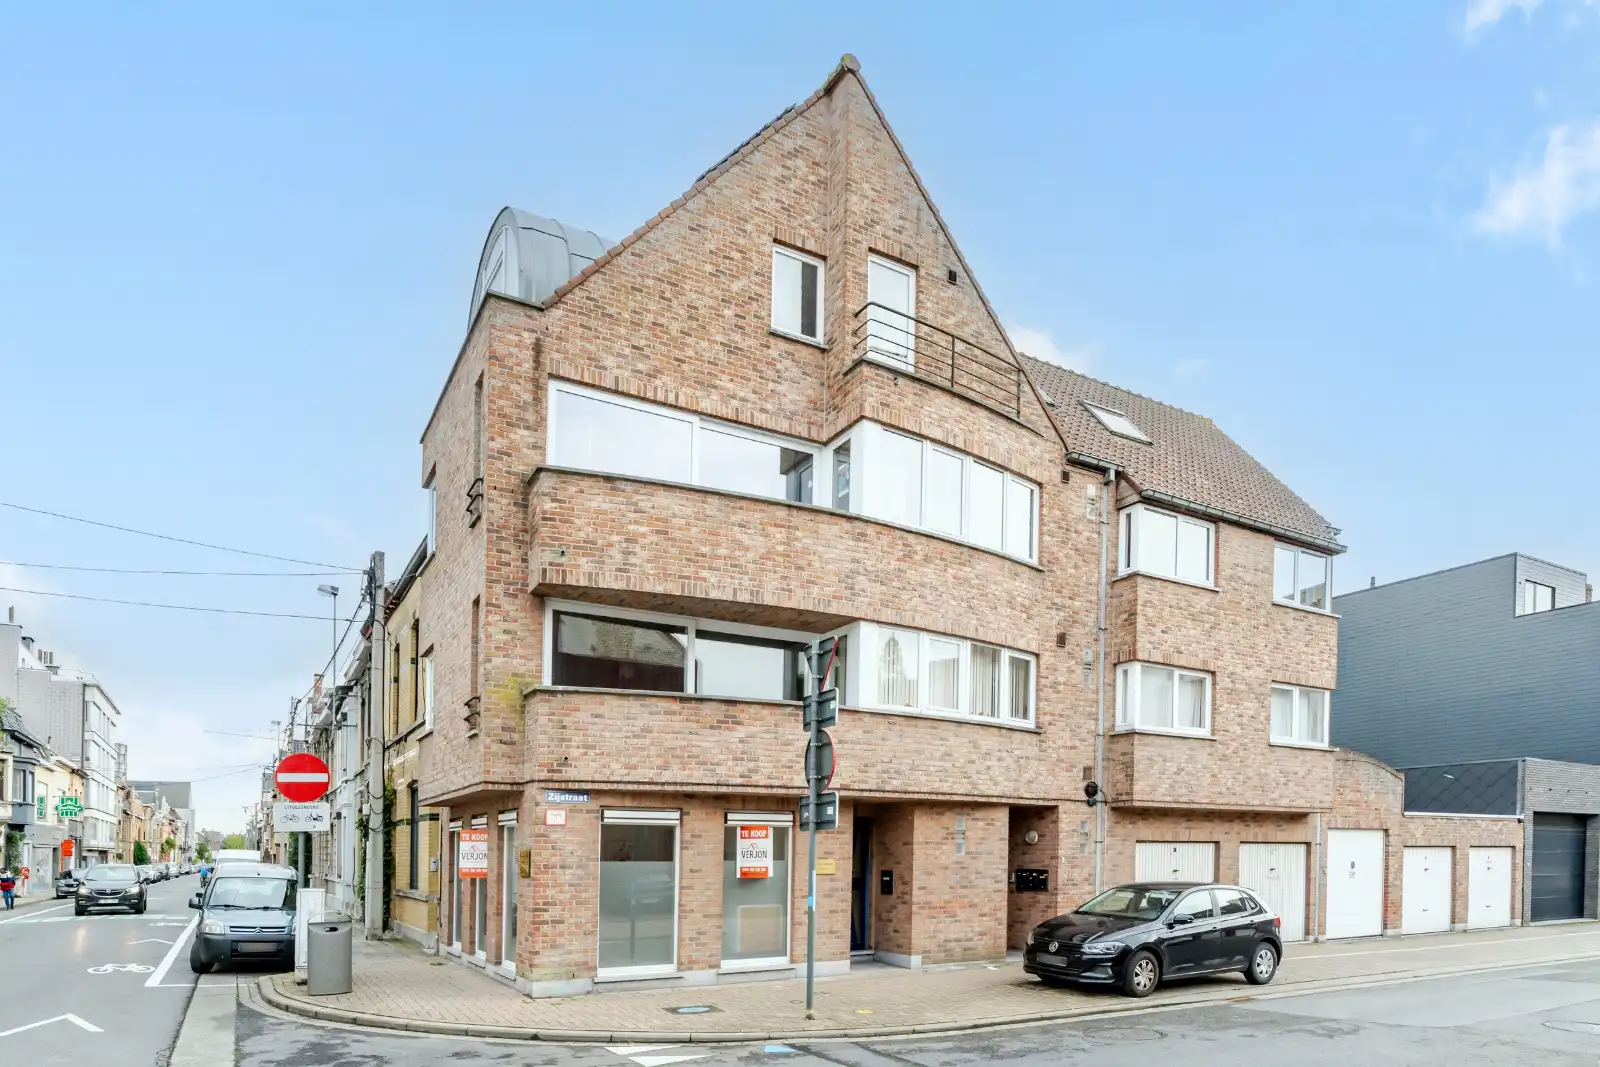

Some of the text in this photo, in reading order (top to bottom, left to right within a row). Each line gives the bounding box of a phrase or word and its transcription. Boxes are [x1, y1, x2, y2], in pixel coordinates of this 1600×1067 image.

[547, 792, 588, 802] Zijstraat
[750, 829, 767, 837] KOOP
[741, 850, 768, 859] VERJON
